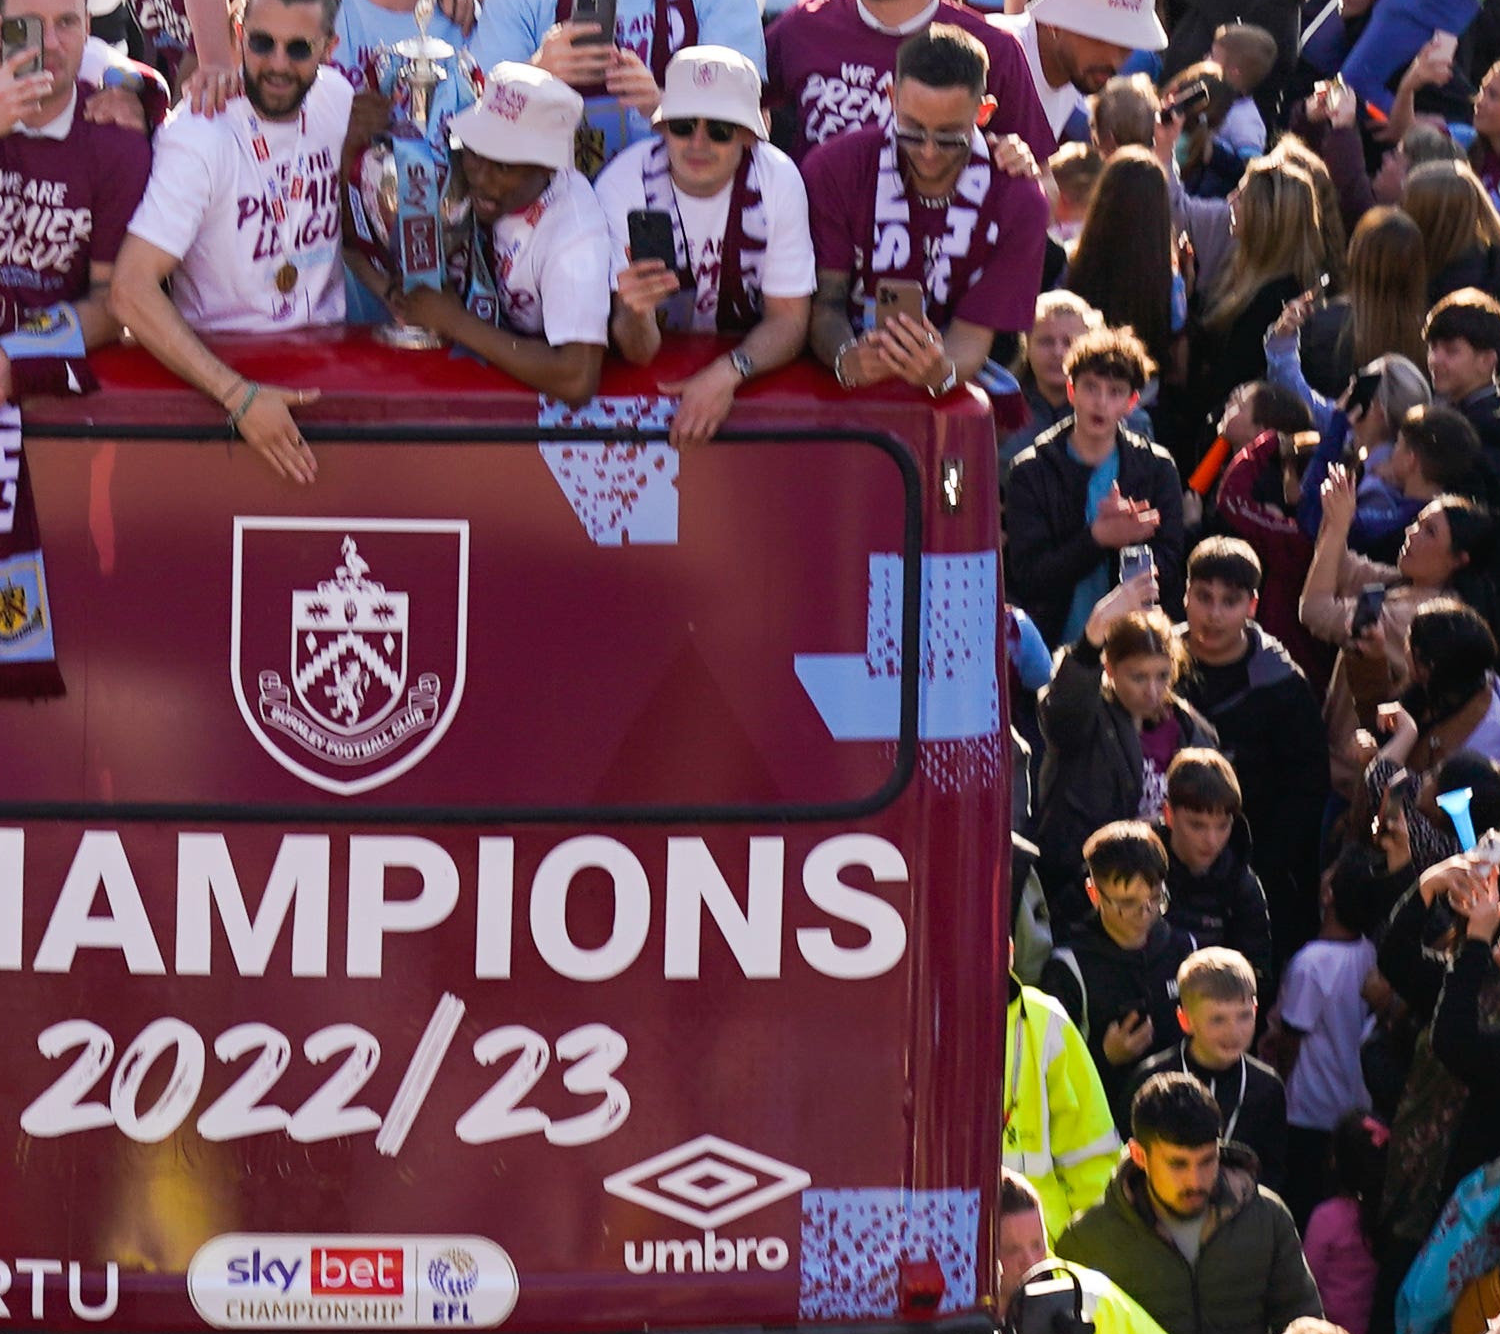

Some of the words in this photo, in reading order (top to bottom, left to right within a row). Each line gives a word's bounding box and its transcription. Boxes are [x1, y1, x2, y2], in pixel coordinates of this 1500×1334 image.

[23, 178, 68, 207] ARE
[18, 991, 632, 1159] 2022/23
[225, 1247, 301, 1294] sky
[317, 1249, 396, 1291] bet
[622, 1230, 790, 1276] umbro
[224, 1300, 404, 1323] CHAMPIONSHIP
[432, 1300, 475, 1324] EFL
